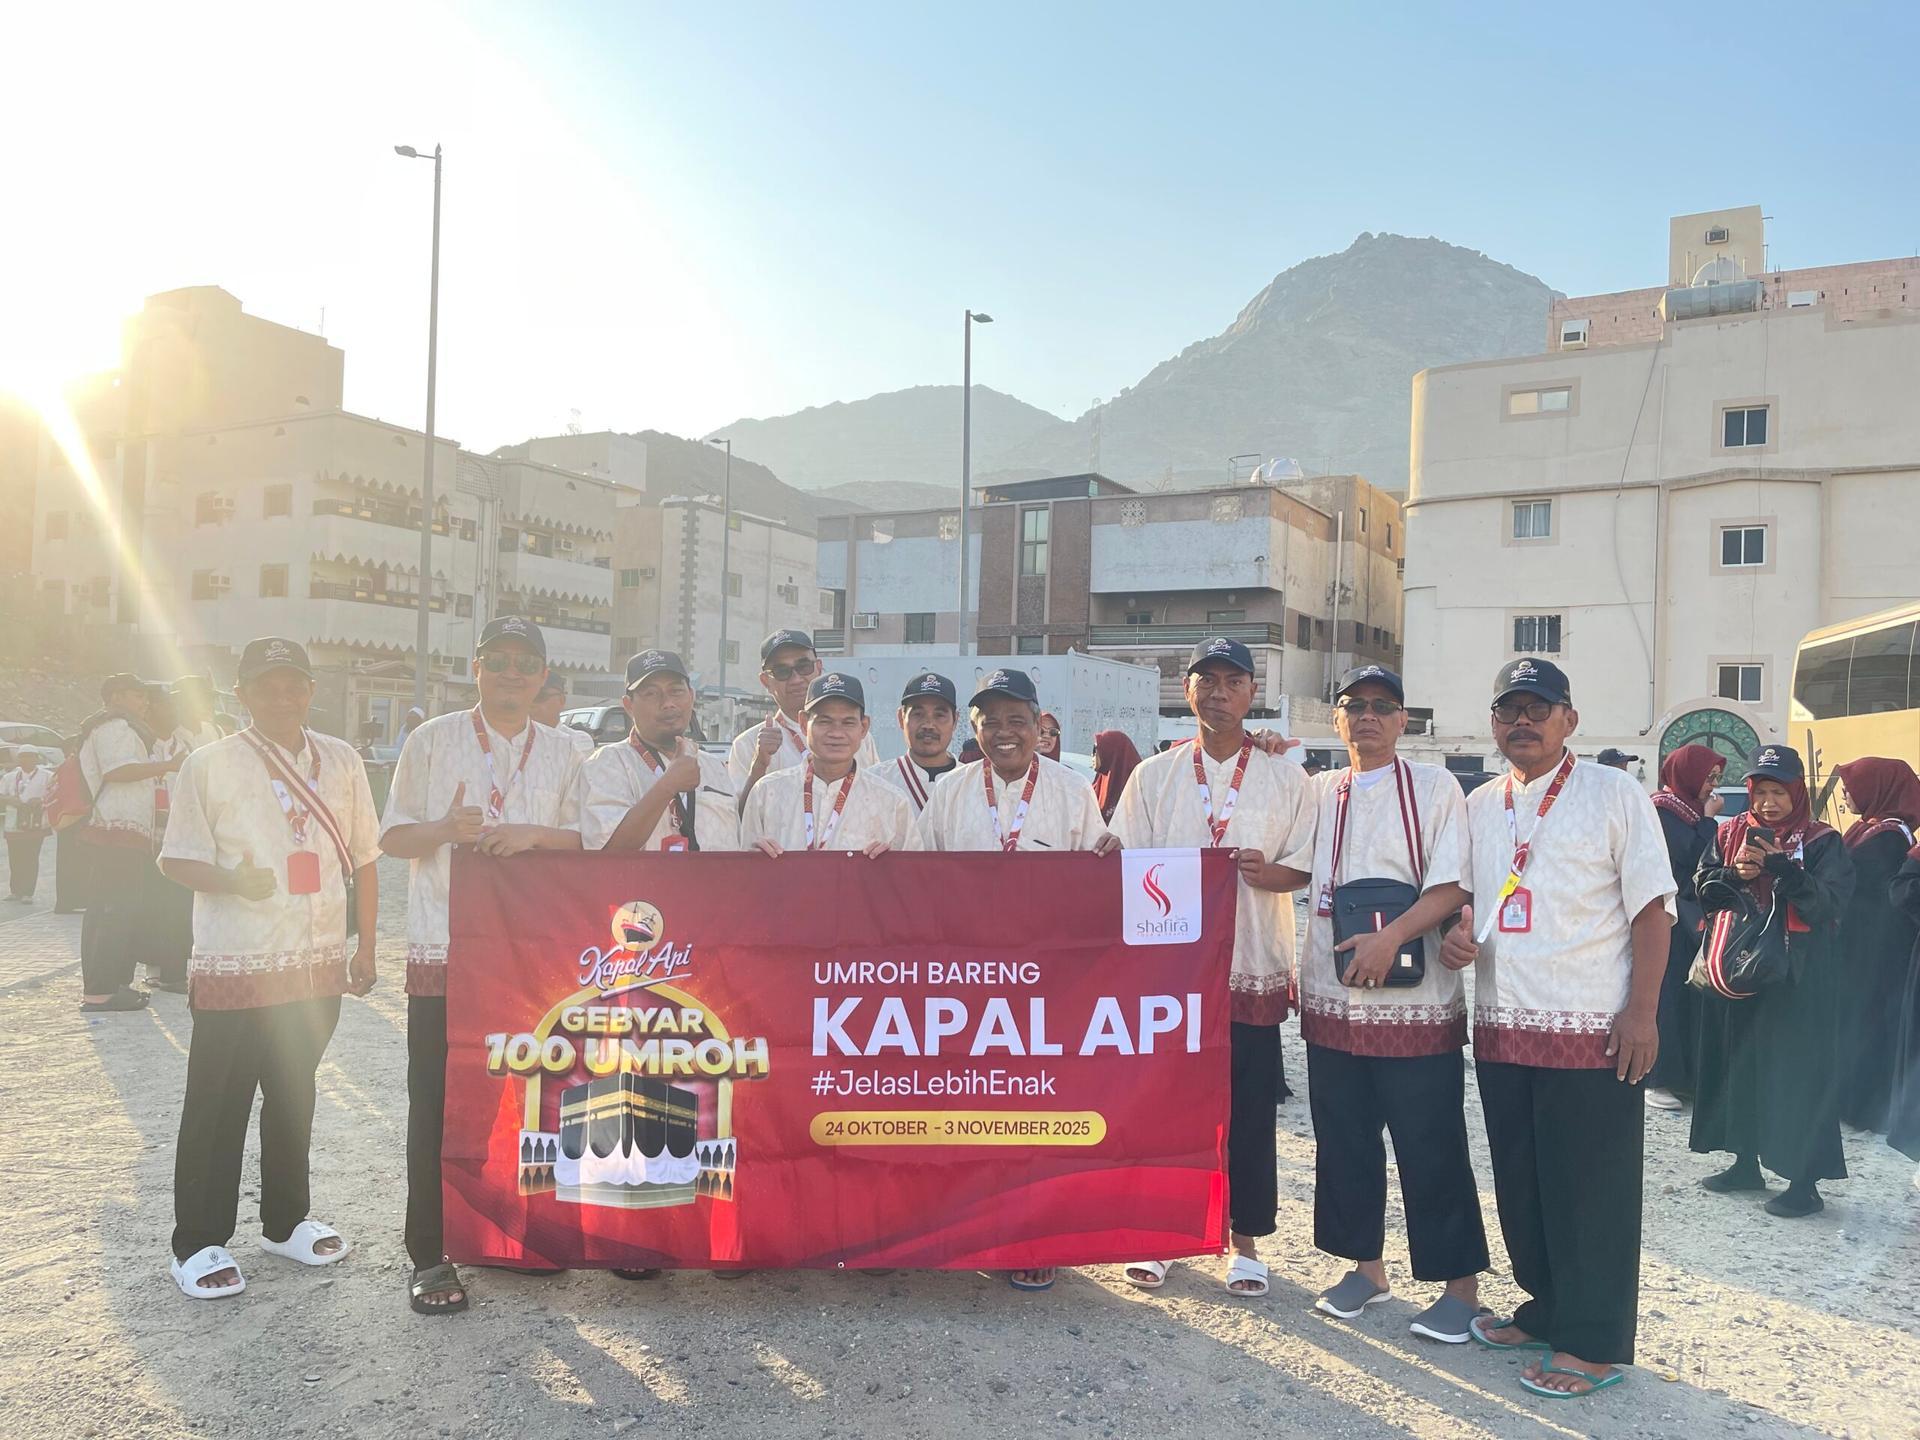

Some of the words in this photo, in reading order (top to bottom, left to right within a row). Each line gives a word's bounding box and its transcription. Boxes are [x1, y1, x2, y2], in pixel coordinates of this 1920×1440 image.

[1136, 919, 1188, 933] shafira
[577, 945, 644, 990] Kapal
[645, 942, 693, 977] Api
[814, 962, 919, 985] UMROH
[928, 962, 1041, 985] BARENG
[560, 1006, 704, 1034] GEBYAR
[812, 996, 1063, 1057] KAPAL
[1079, 993, 1202, 1055] API
[486, 1033, 576, 1075] 100
[586, 1037, 769, 1077] UMROH
[811, 1069, 1056, 1096] #JelasLebihEnak
[825, 1121, 845, 1136] 24
[847, 1121, 928, 1136] OKTOBER
[944, 1121, 954, 1135] 3
[957, 1121, 1049, 1136] NOVEMBER
[1053, 1121, 1091, 1136] 2025
